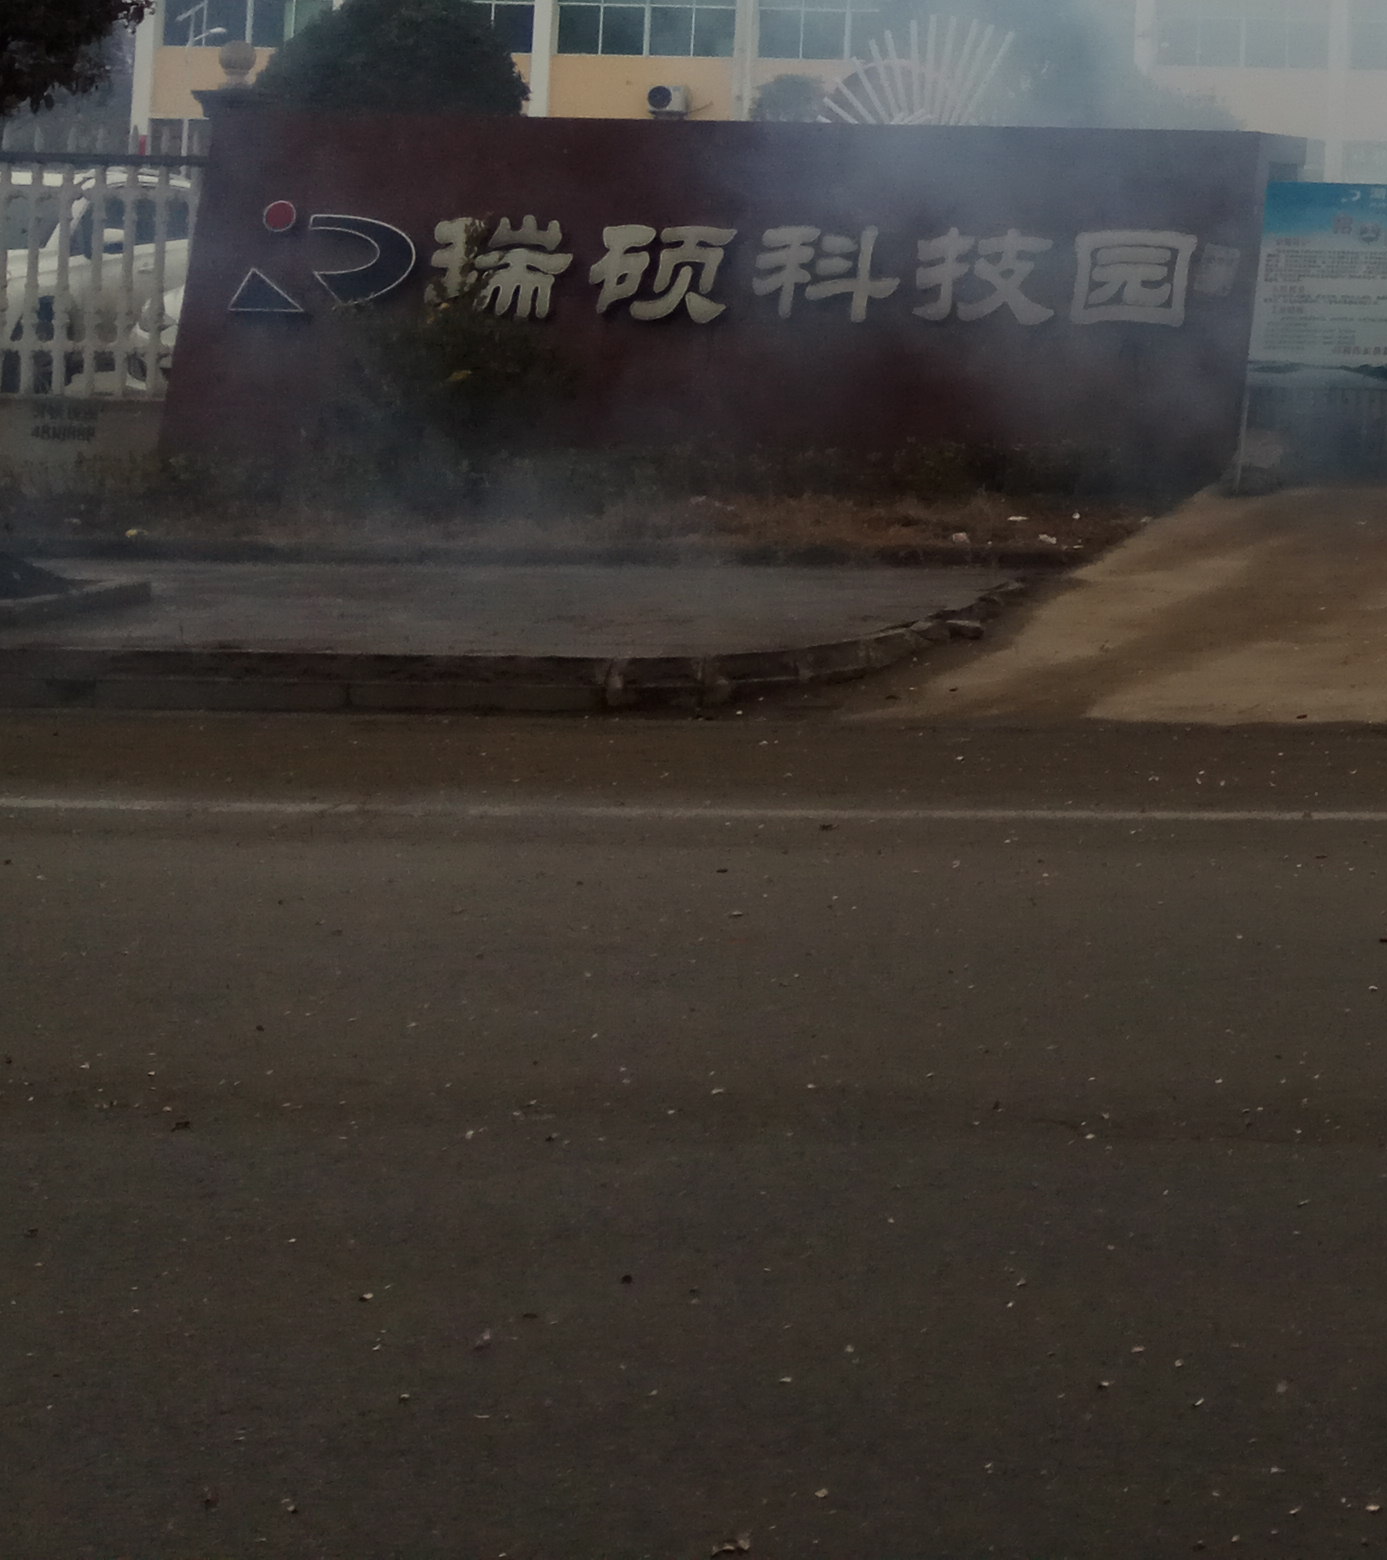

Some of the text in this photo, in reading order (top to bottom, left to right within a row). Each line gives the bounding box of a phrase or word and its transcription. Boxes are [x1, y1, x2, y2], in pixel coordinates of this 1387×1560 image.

[424, 214, 1199, 328] 瑞硕科技园
